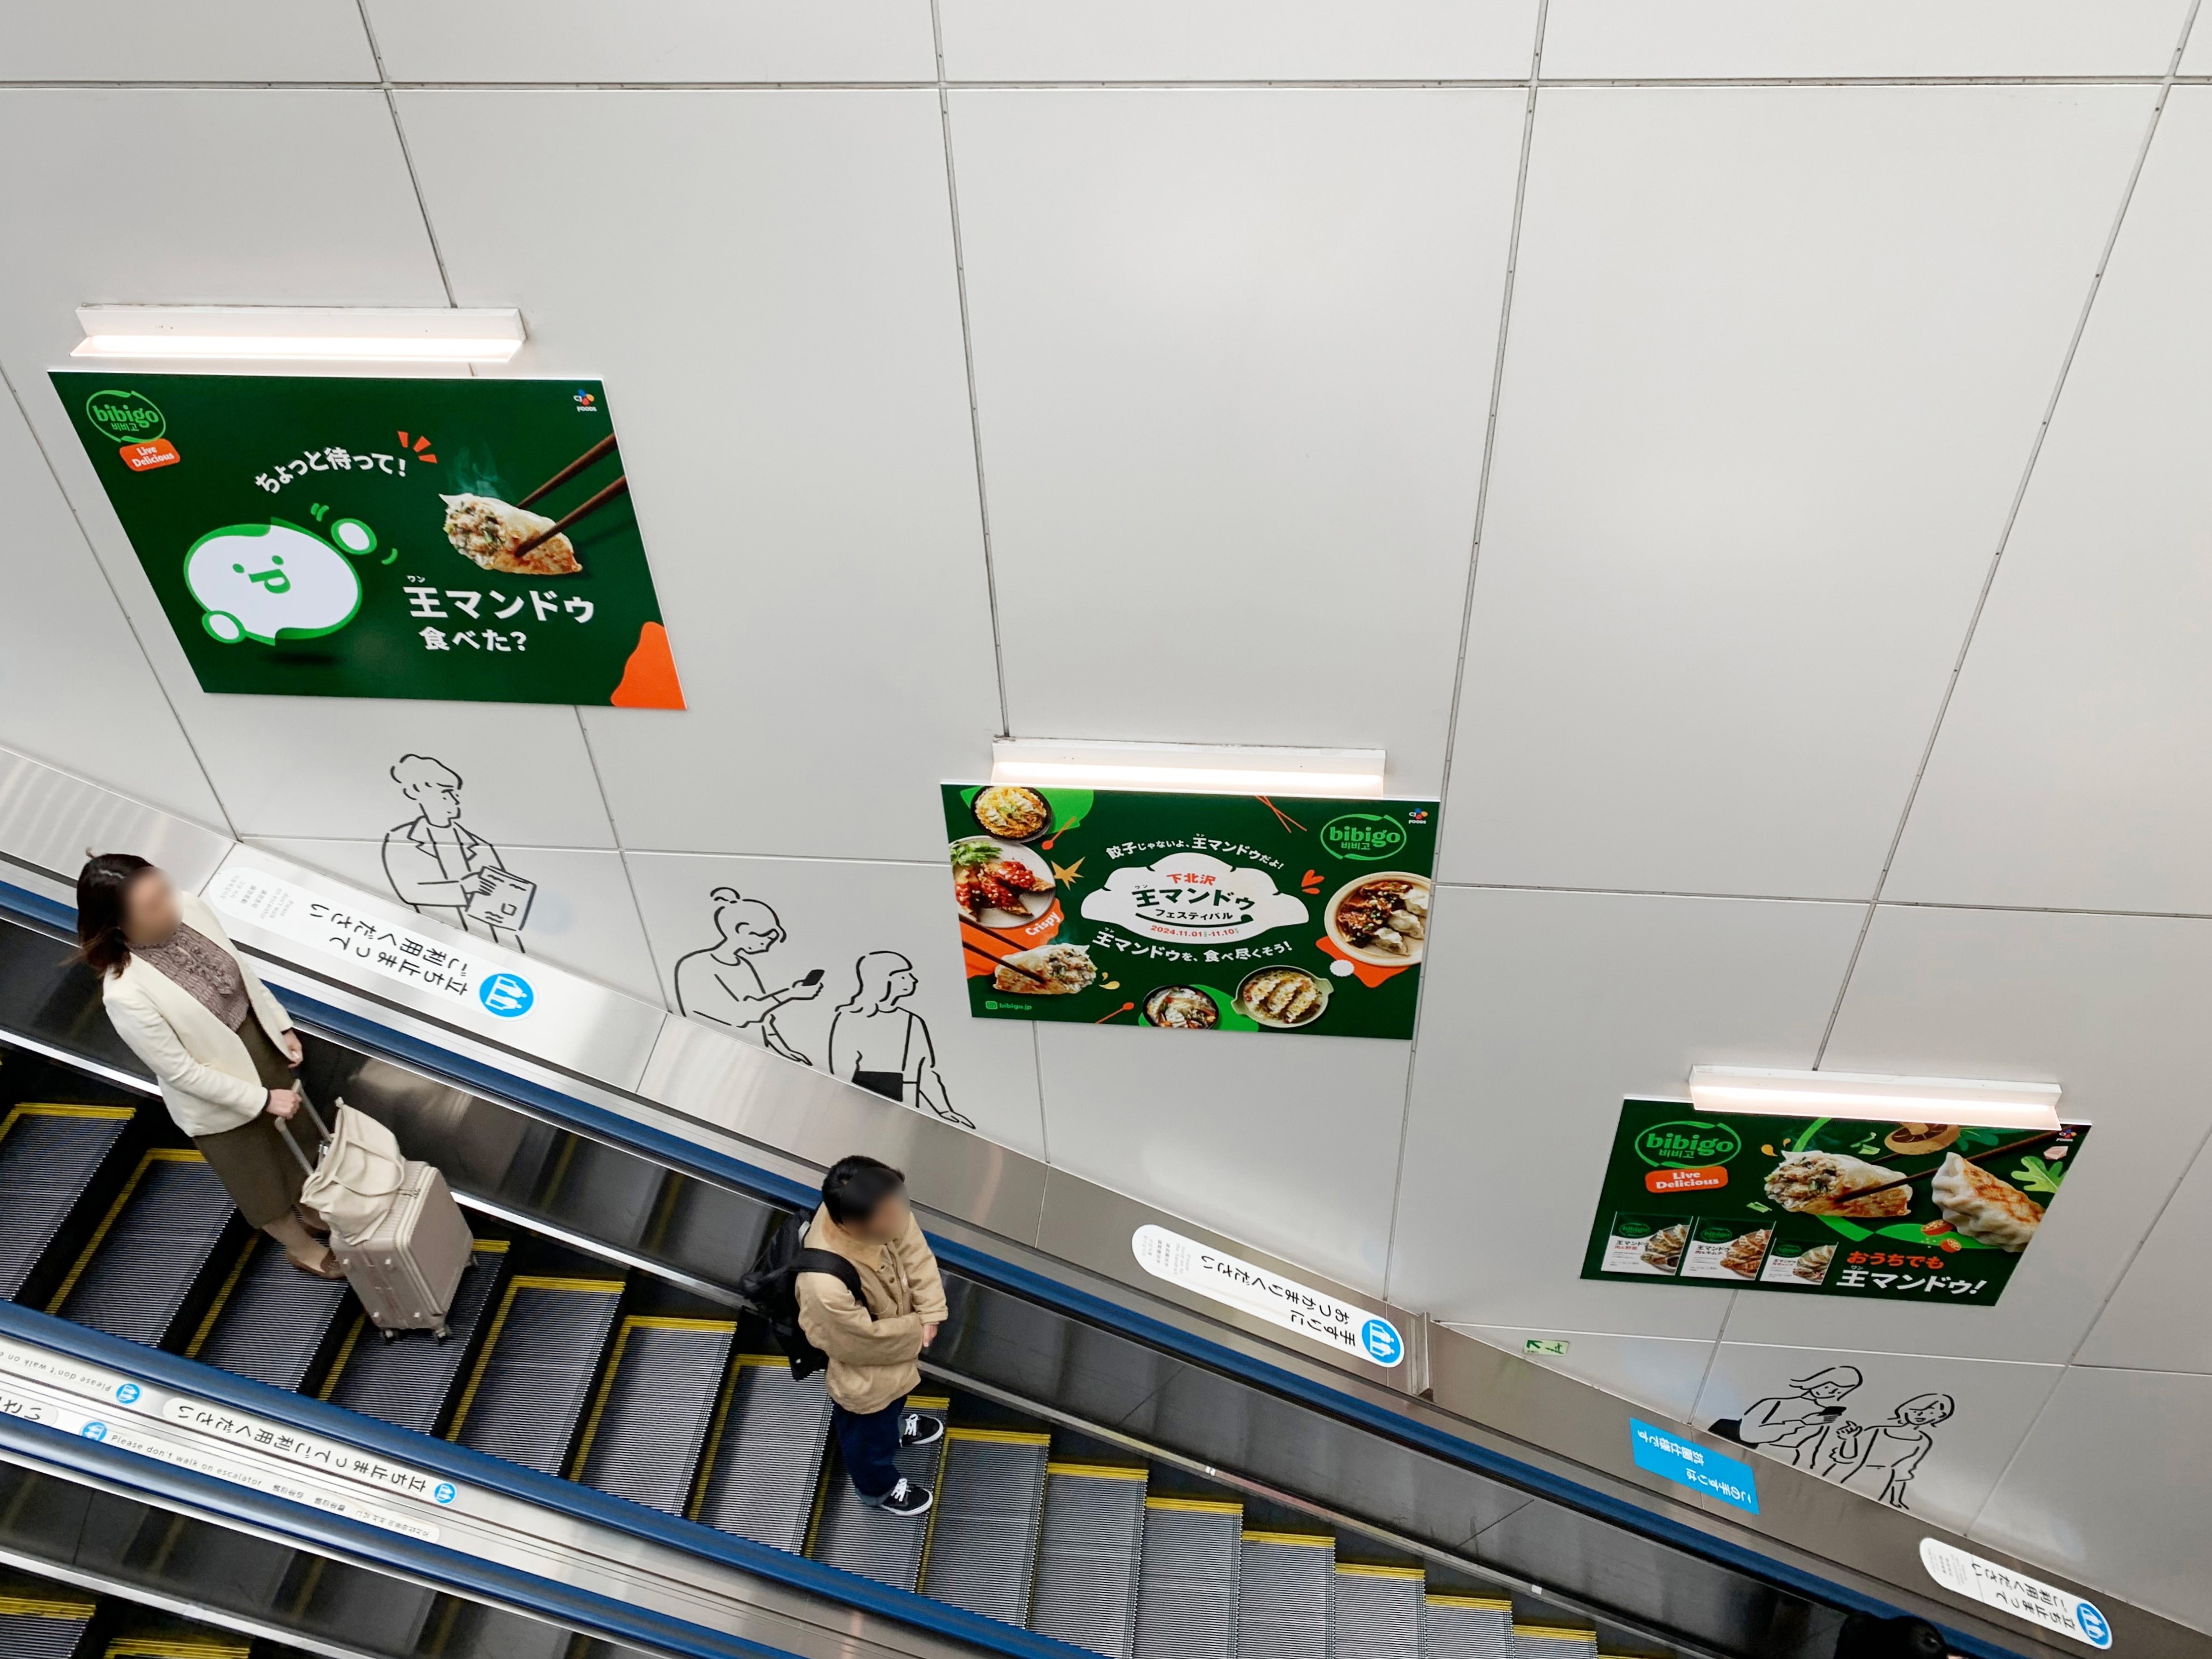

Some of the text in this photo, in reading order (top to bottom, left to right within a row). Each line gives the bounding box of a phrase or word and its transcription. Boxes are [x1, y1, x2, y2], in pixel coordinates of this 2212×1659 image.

[92, 404, 159, 428] bibigo
[111, 423, 139, 431] 비비고
[131, 452, 174, 468] Delicious
[136, 446, 157, 456] Live
[255, 446, 406, 494] ちょっと待って!
[402, 587, 594, 623] 王マンドゥ
[419, 626, 527, 651] 食べた?
[1330, 826, 1401, 847] bibigo
[1167, 873, 1216, 886] 下北沢
[1131, 888, 1255, 910] 王マンドゥ
[1025, 912, 1061, 936] Crispy
[1155, 909, 1233, 921] フェスティバル
[310, 903, 468, 977] ご利用ください
[330, 937, 468, 996] 立ち止まって
[1646, 1133, 1734, 1156] bibigo
[1659, 1149, 1694, 1158] 비비고
[1656, 1178, 1720, 1189] Delicious
[1847, 1251, 1944, 1269] おうちでも
[1200, 1255, 1350, 1325] おつかまりください
[1836, 1269, 1987, 1294] 王マンドゥ!
[1291, 1309, 1356, 1346] 手すりに
[24, 1359, 46, 1370] walk
[50, 1367, 77, 1380] don't
[80, 1376, 112, 1392] Please
[111, 1434, 262, 1486] Please don't walk on escalator
